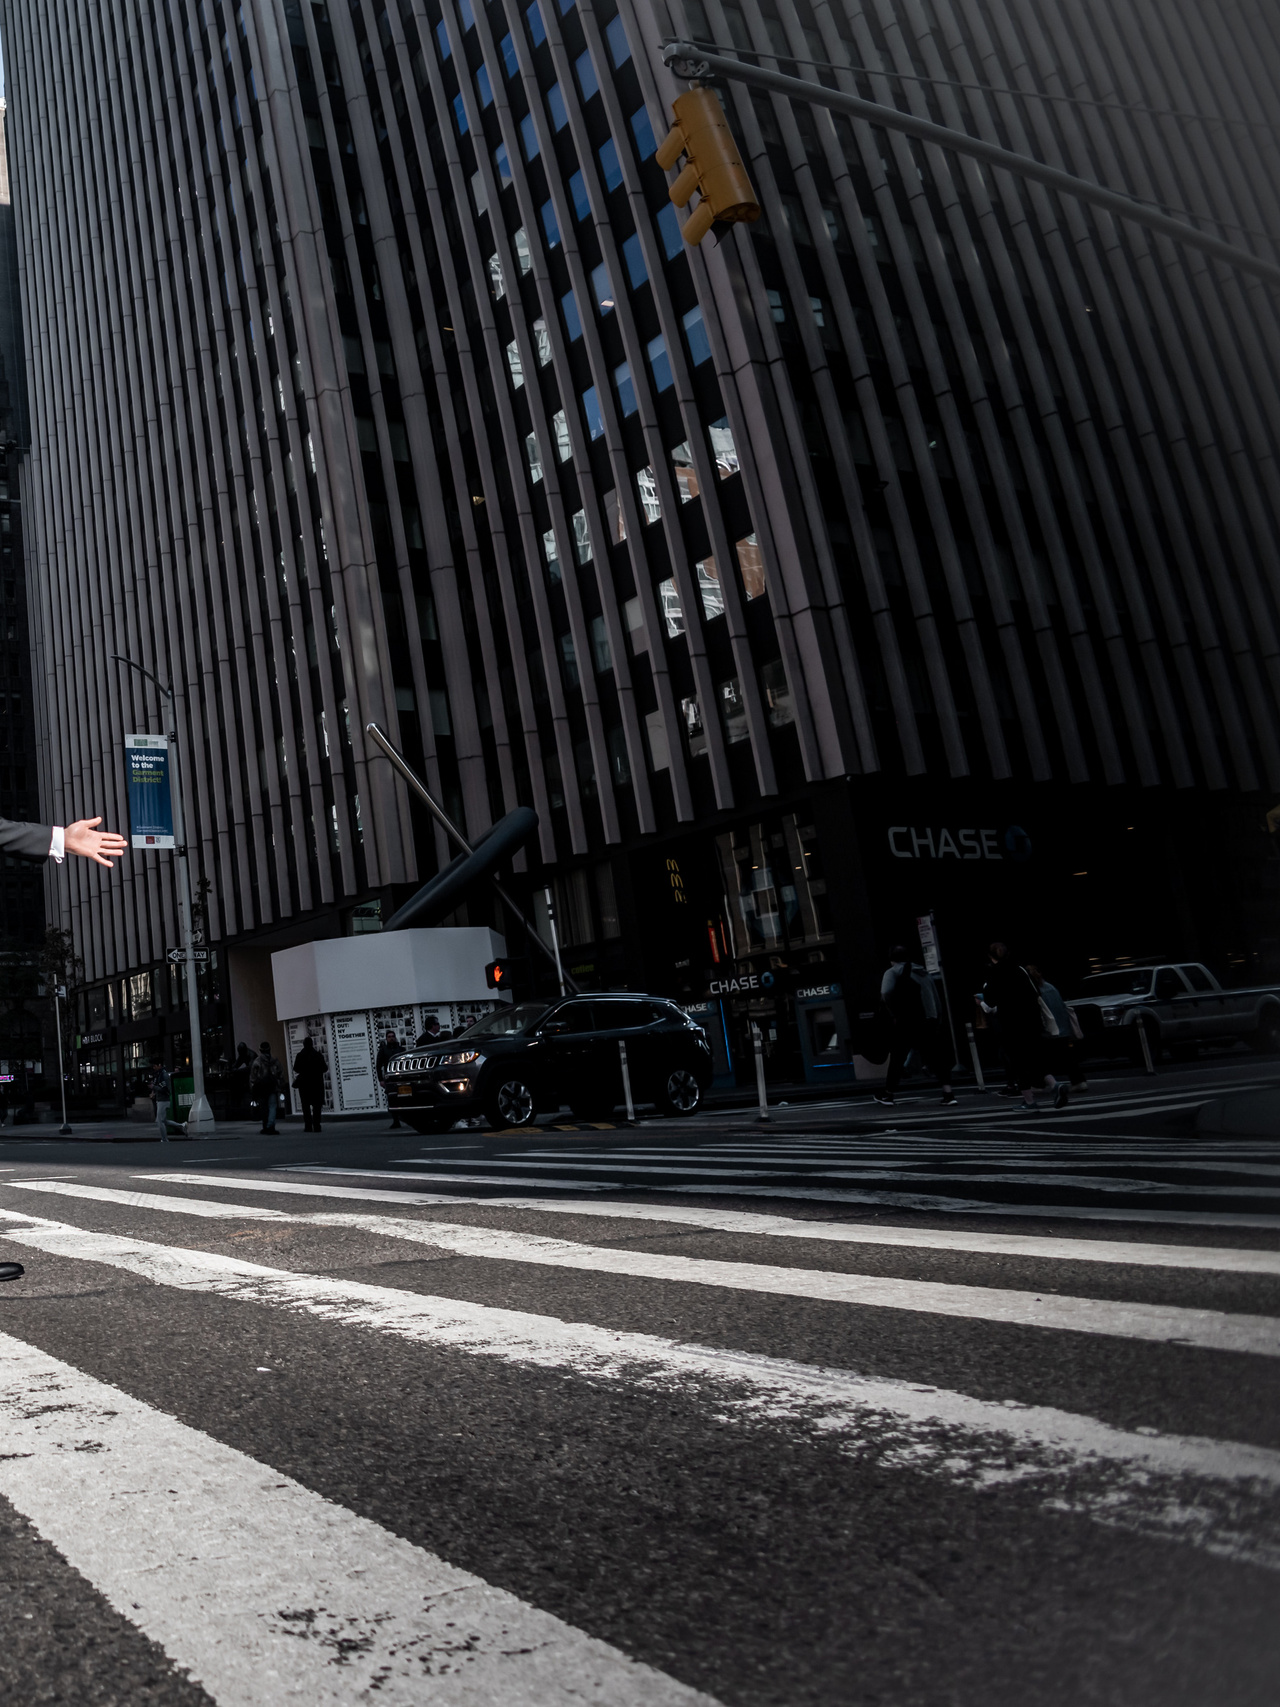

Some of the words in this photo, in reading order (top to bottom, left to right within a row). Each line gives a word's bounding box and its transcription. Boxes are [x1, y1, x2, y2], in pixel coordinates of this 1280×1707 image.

[131, 754, 165, 762] Welcome
[132, 769, 164, 777] Garment
[132, 776, 162, 784] District!
[888, 826, 1003, 859] CHASE
[709, 975, 760, 994] CHASE
[797, 985, 830, 998] CHASE
[90, 1033, 103, 1043] BLOCK
